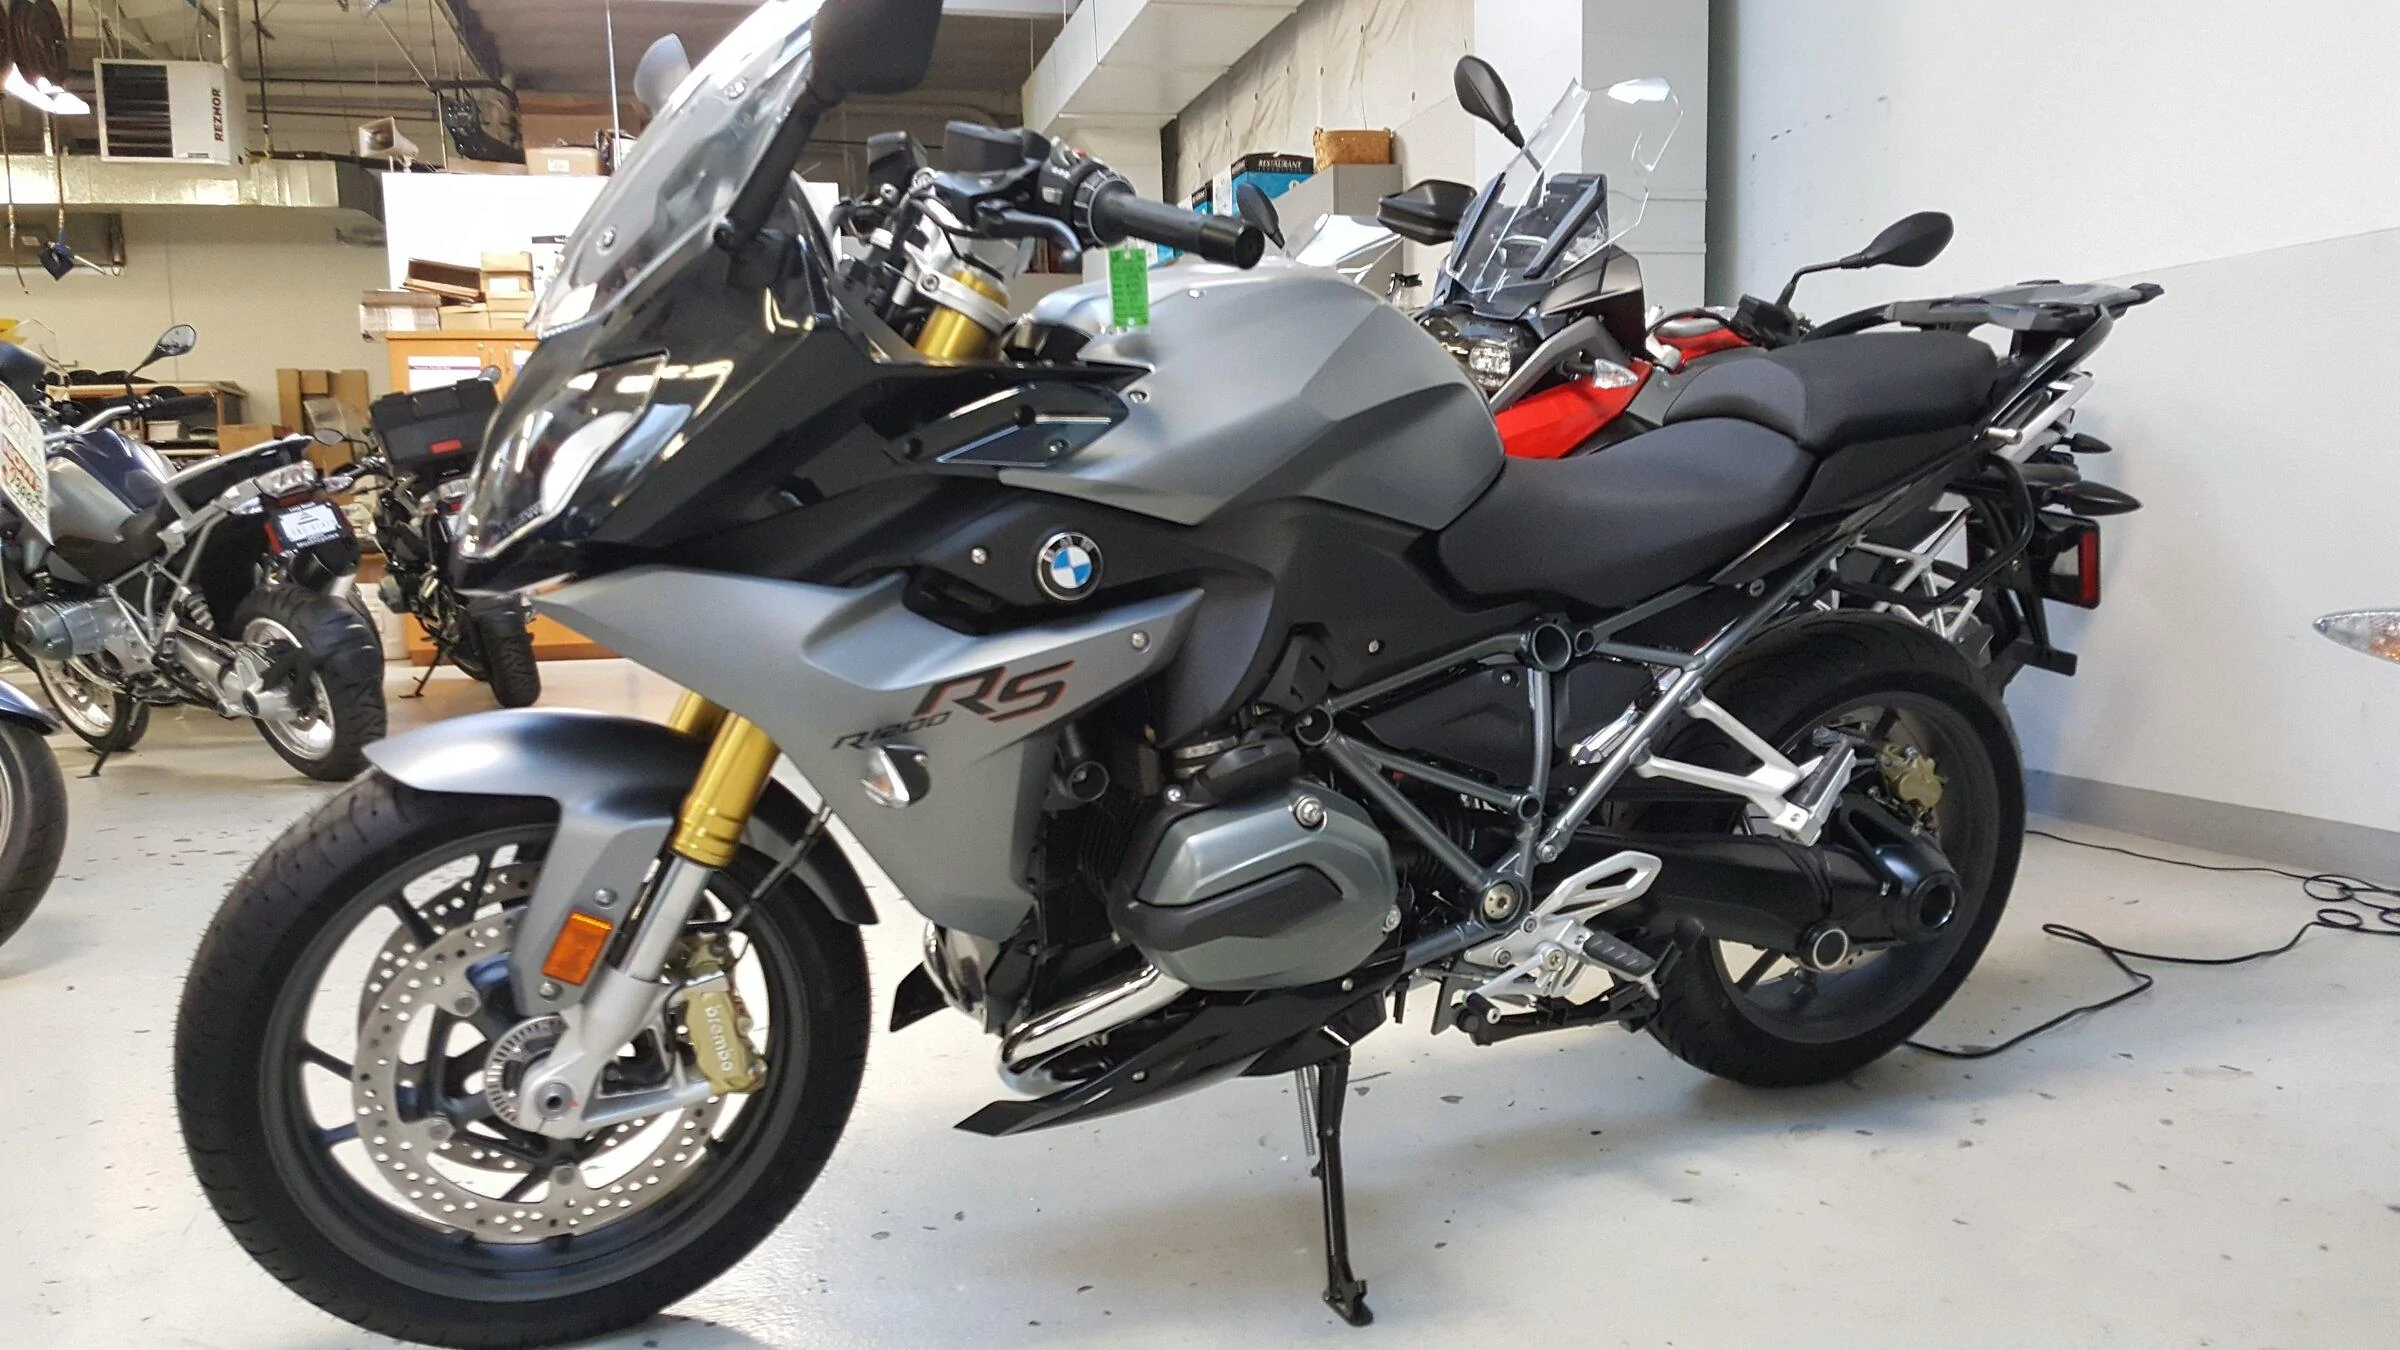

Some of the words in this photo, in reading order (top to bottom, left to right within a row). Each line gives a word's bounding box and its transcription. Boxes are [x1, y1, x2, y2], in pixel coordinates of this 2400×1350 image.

[211, 87, 223, 142] REZNOR
[1258, 160, 1302, 169] RESTAURANT
[912, 659, 1076, 723] RS
[831, 710, 953, 750] R1200
[704, 1004, 734, 1071] brembo
